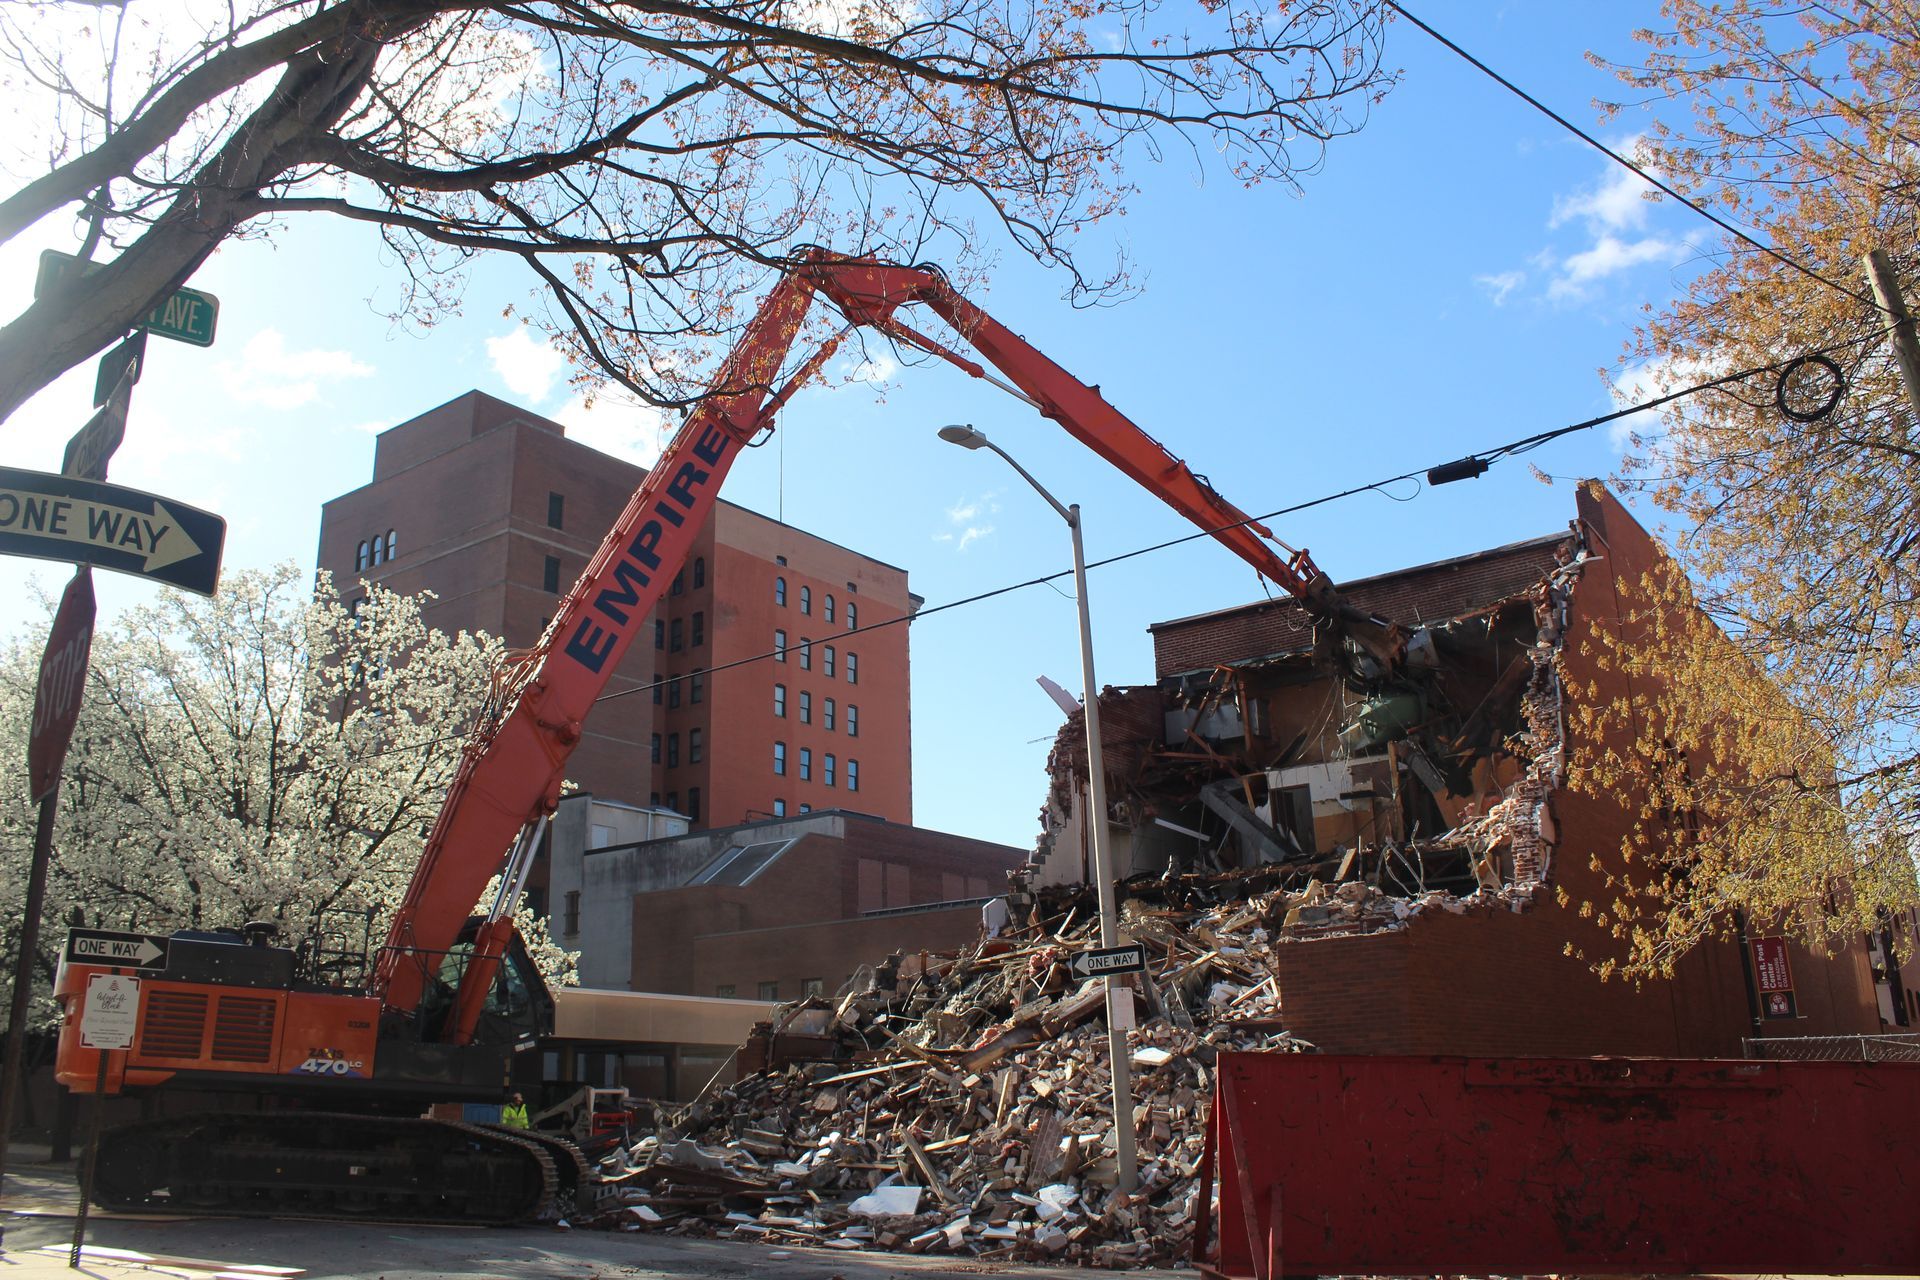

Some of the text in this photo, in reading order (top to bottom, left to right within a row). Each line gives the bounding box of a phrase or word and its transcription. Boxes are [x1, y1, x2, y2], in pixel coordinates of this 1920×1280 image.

[162, 295, 202, 335] AVE.
[0, 494, 170, 553] ONE WAY
[564, 424, 731, 674] EMPIRE
[34, 627, 88, 738] STOP
[78, 939, 141, 957] ONE WAY
[1088, 953, 1134, 968] ONE WAY
[1756, 944, 1764, 961] Post
[1768, 963, 1776, 988] Center
